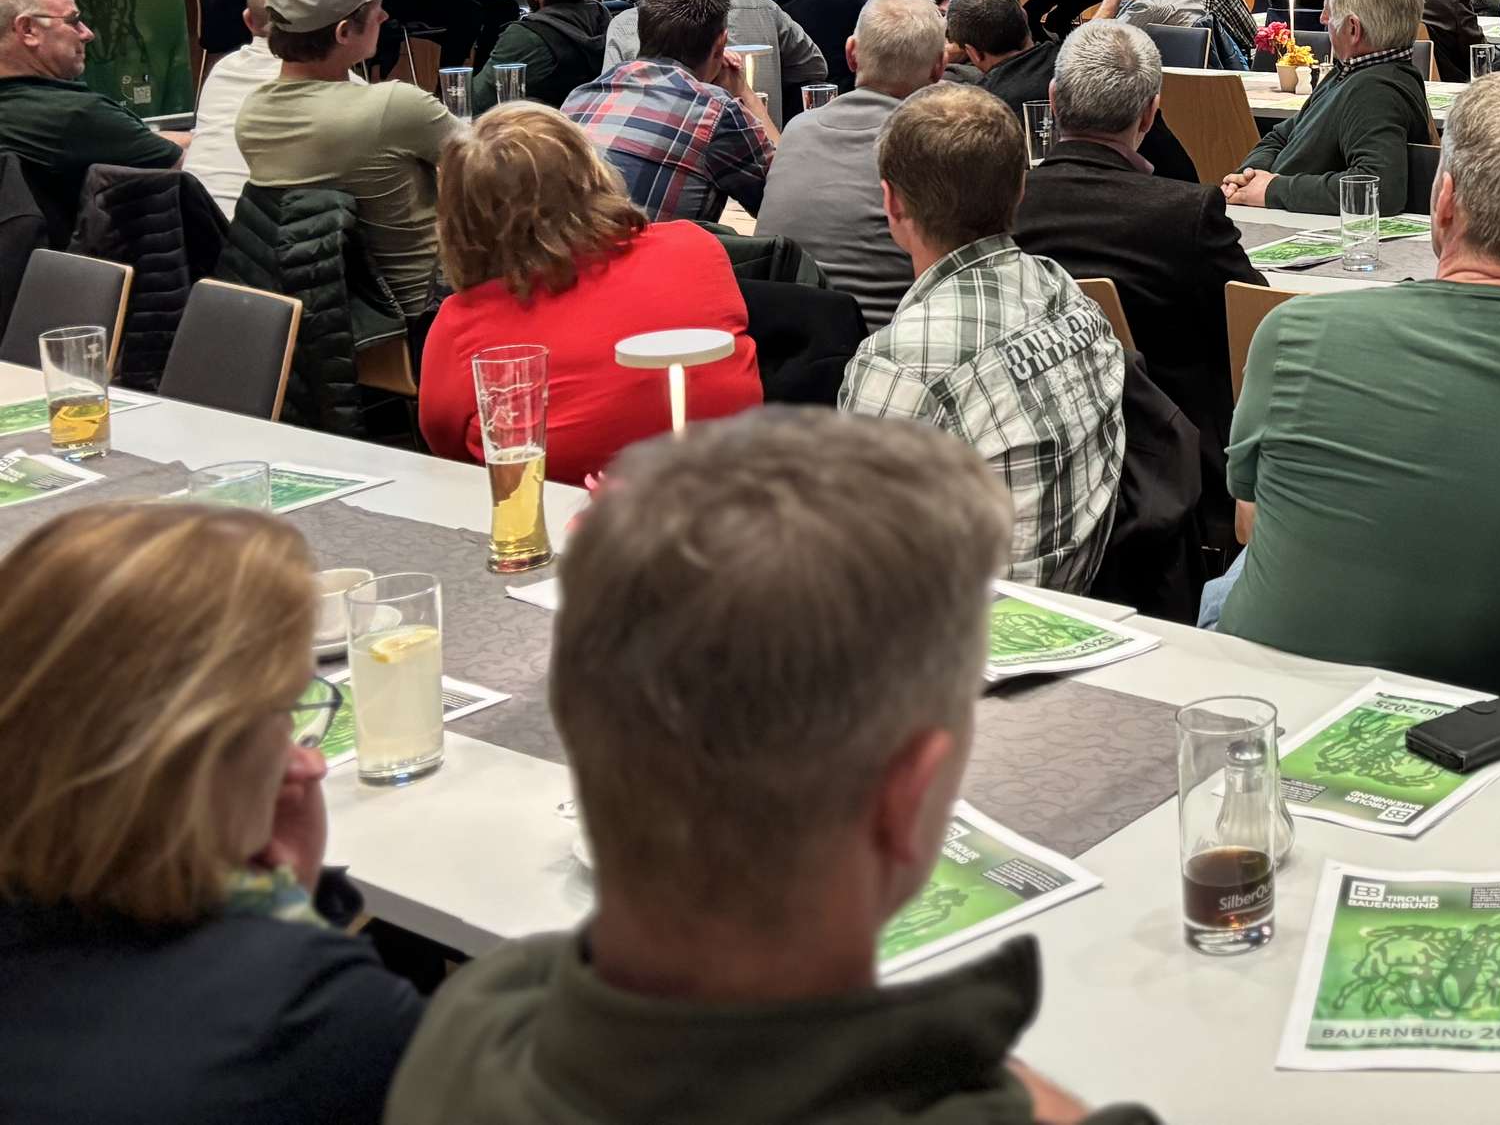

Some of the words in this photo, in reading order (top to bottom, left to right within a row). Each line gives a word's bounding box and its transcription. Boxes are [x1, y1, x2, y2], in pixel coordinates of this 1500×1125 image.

[1375, 700, 1418, 714] 2025
[1344, 794, 1388, 810] TIROLER
[1347, 899, 1439, 909] BAUERNBUND
[1385, 895, 1439, 904] TIROLER
[1321, 1026, 1473, 1040] BAUERNBUND
